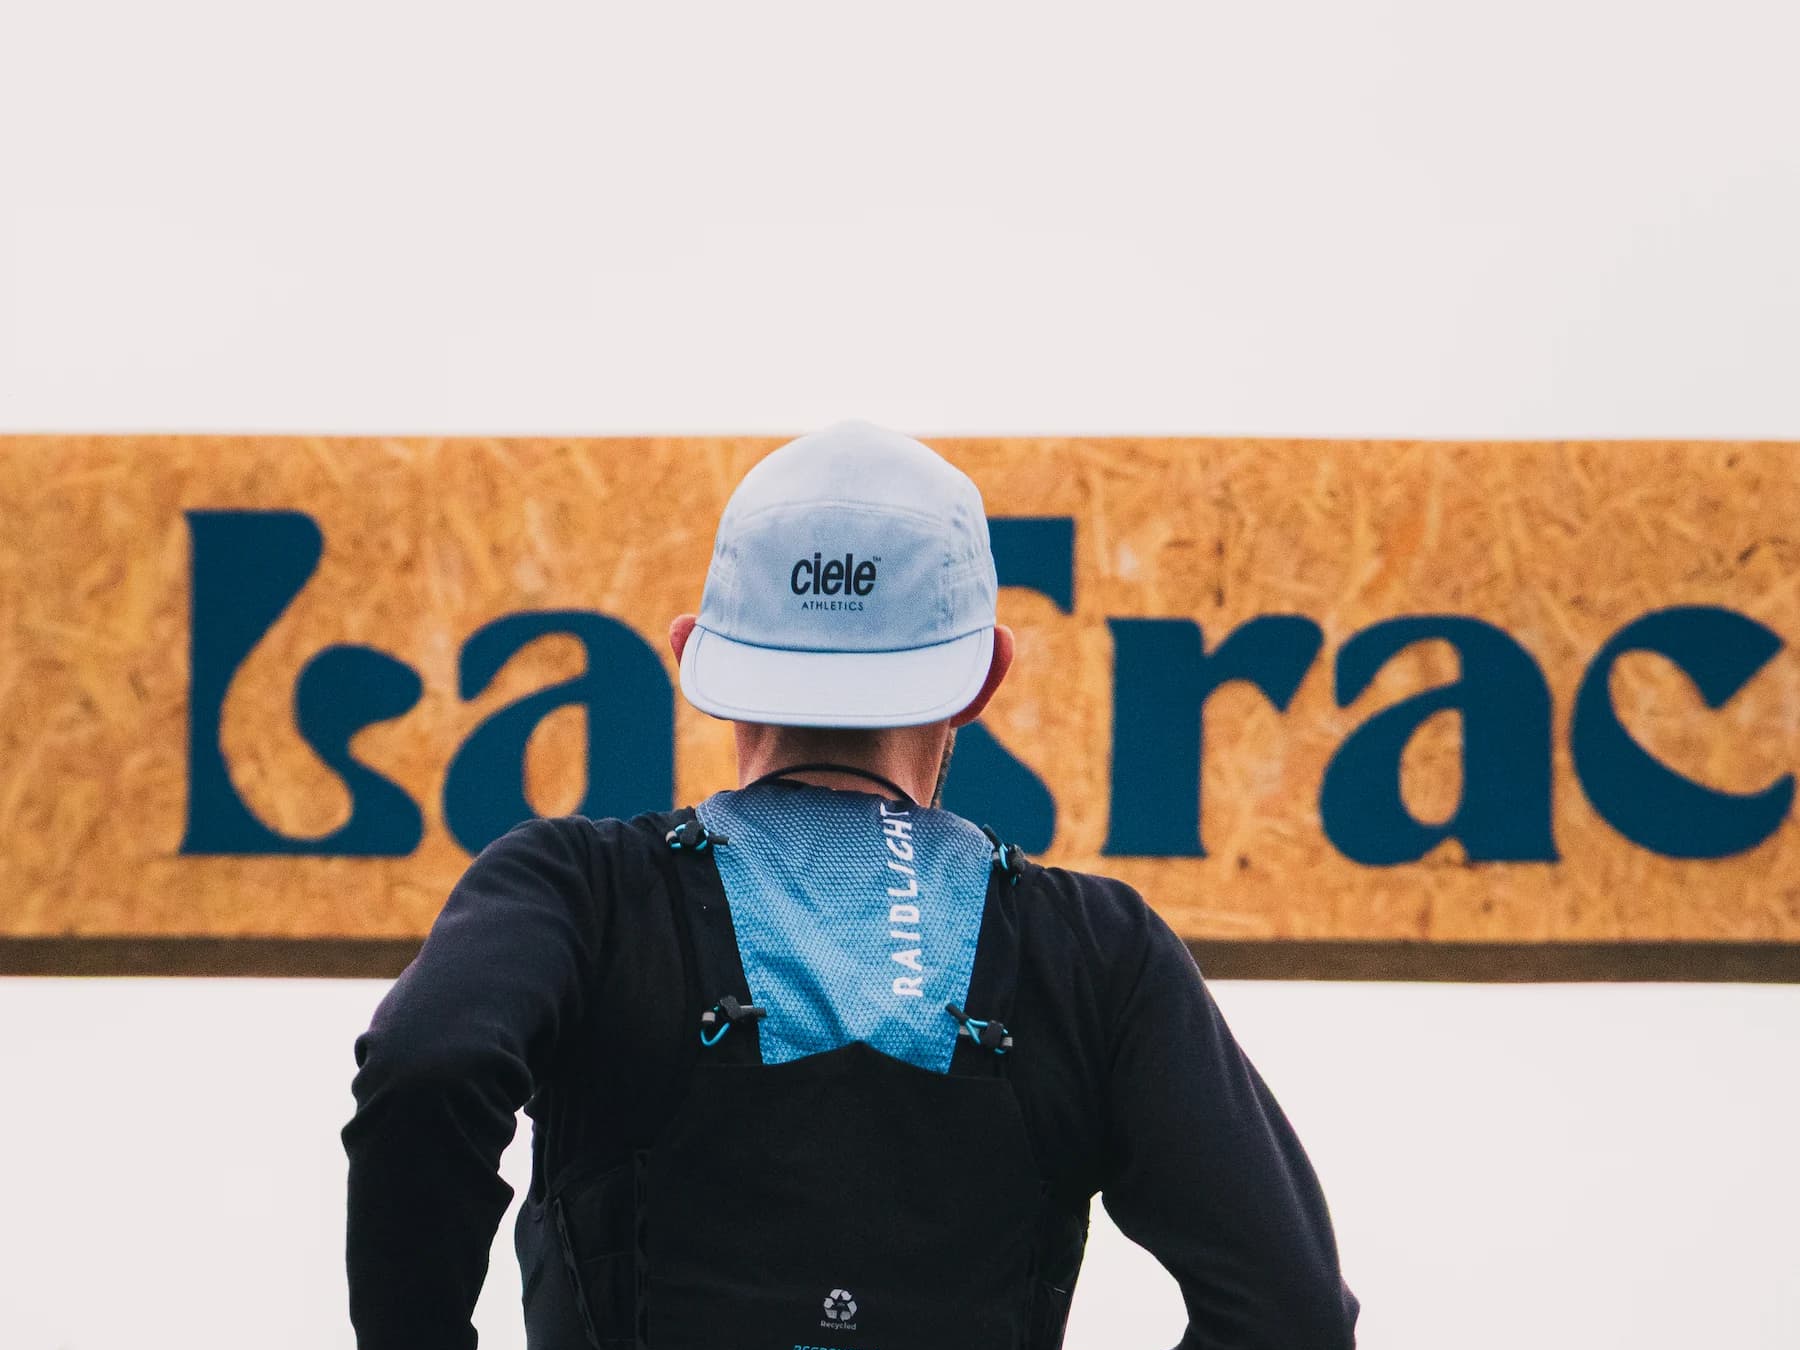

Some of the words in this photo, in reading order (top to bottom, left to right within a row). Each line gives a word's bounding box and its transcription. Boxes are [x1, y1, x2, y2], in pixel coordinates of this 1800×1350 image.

[801, 601, 864, 612] ATHLETICS
[880, 802, 924, 998] RAIDLIGHT
[820, 1320, 857, 1331] Recycled
